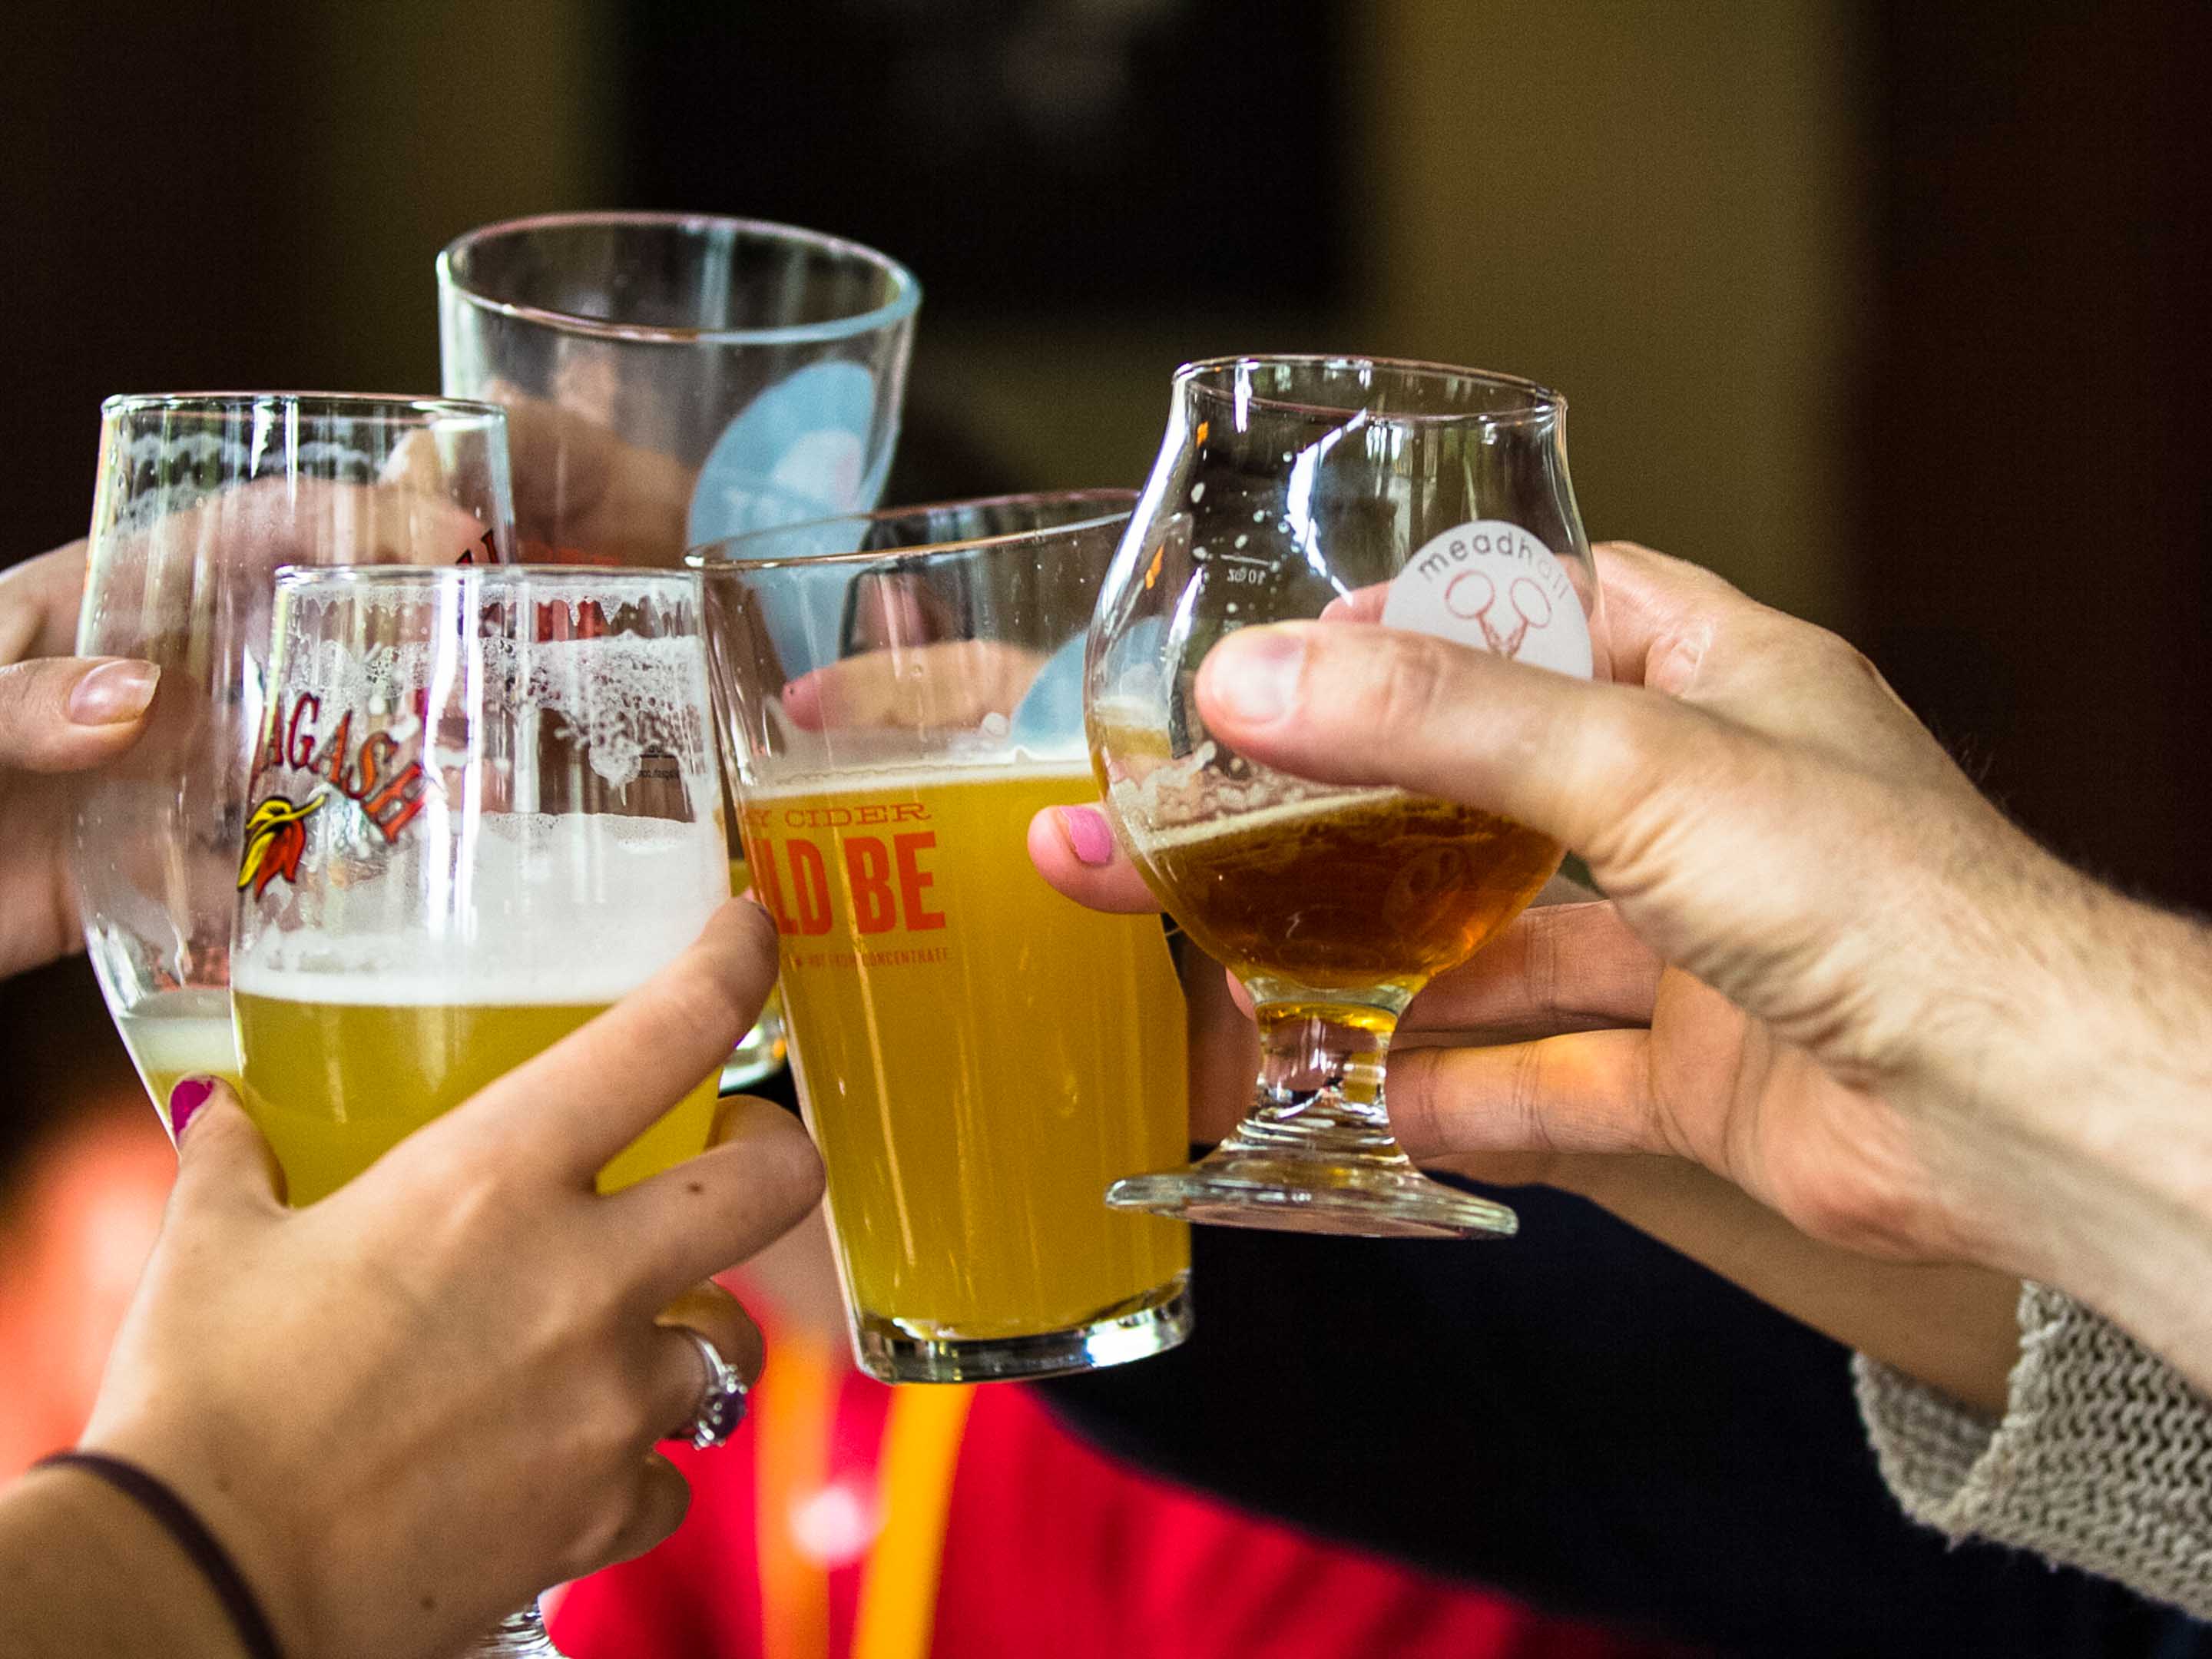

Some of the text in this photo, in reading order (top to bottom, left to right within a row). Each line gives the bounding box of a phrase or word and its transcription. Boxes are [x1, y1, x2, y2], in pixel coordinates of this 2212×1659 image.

[1418, 532, 1570, 599] meadhall
[785, 803, 932, 827] CIDER
[843, 831, 946, 935] BE
